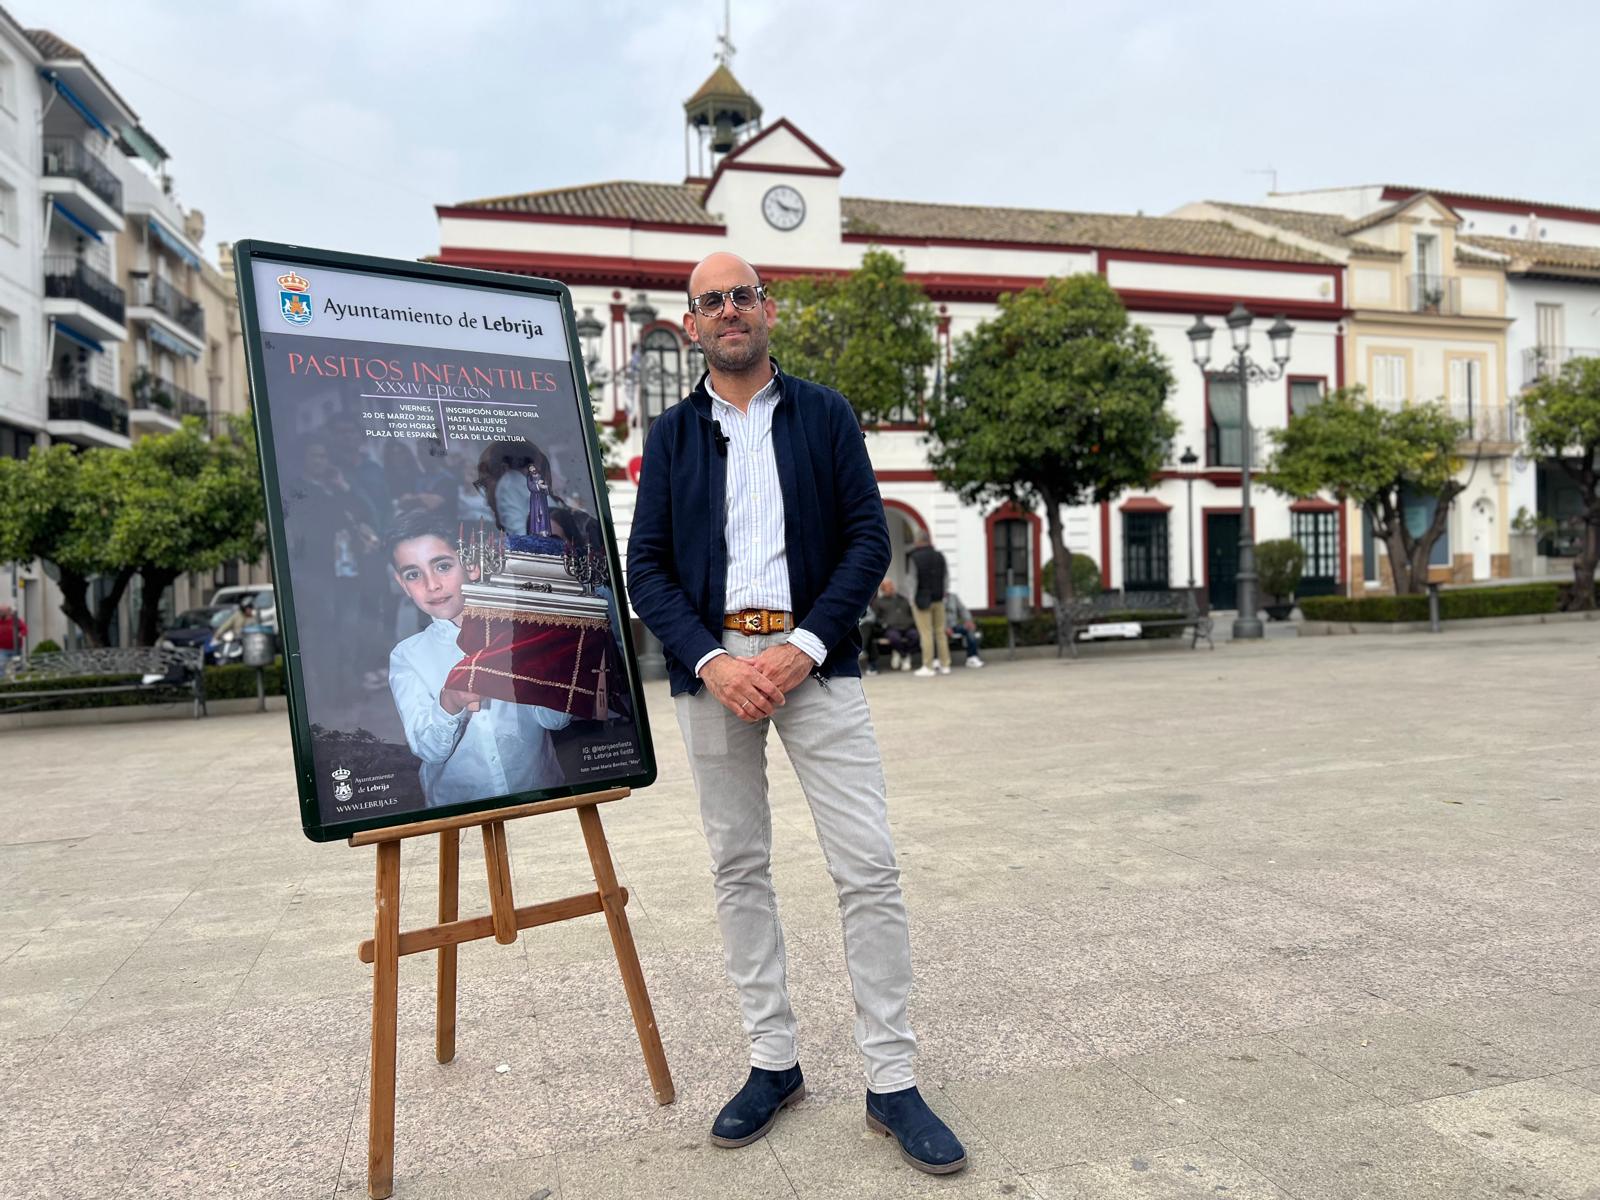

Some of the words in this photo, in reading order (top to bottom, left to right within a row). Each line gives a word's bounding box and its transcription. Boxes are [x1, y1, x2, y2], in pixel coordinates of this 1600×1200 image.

[323, 298, 453, 326] Ayuntamiento
[458, 311, 478, 329] de
[482, 315, 544, 340] Lebrija
[288, 352, 404, 381] PASITOS
[412, 361, 558, 392] INFANTILES
[375, 381, 422, 394] XXXIV
[427, 384, 491, 399] EDICIÓN
[399, 404, 434, 413] VIERNES,
[445, 407, 492, 415] INSCRIPCIÓN
[492, 409, 540, 418] OBLIGATORIA
[362, 411, 373, 419] 20
[387, 413, 415, 421] MARZO
[409, 422, 436, 430] HORAS
[468, 425, 495, 433] MARZO
[365, 429, 392, 437] PLAZA
[393, 430, 405, 438] DE
[406, 430, 438, 439] ESPAÑA
[493, 434, 526, 442] CULTURA
[366, 783, 390, 792] Lebrija
